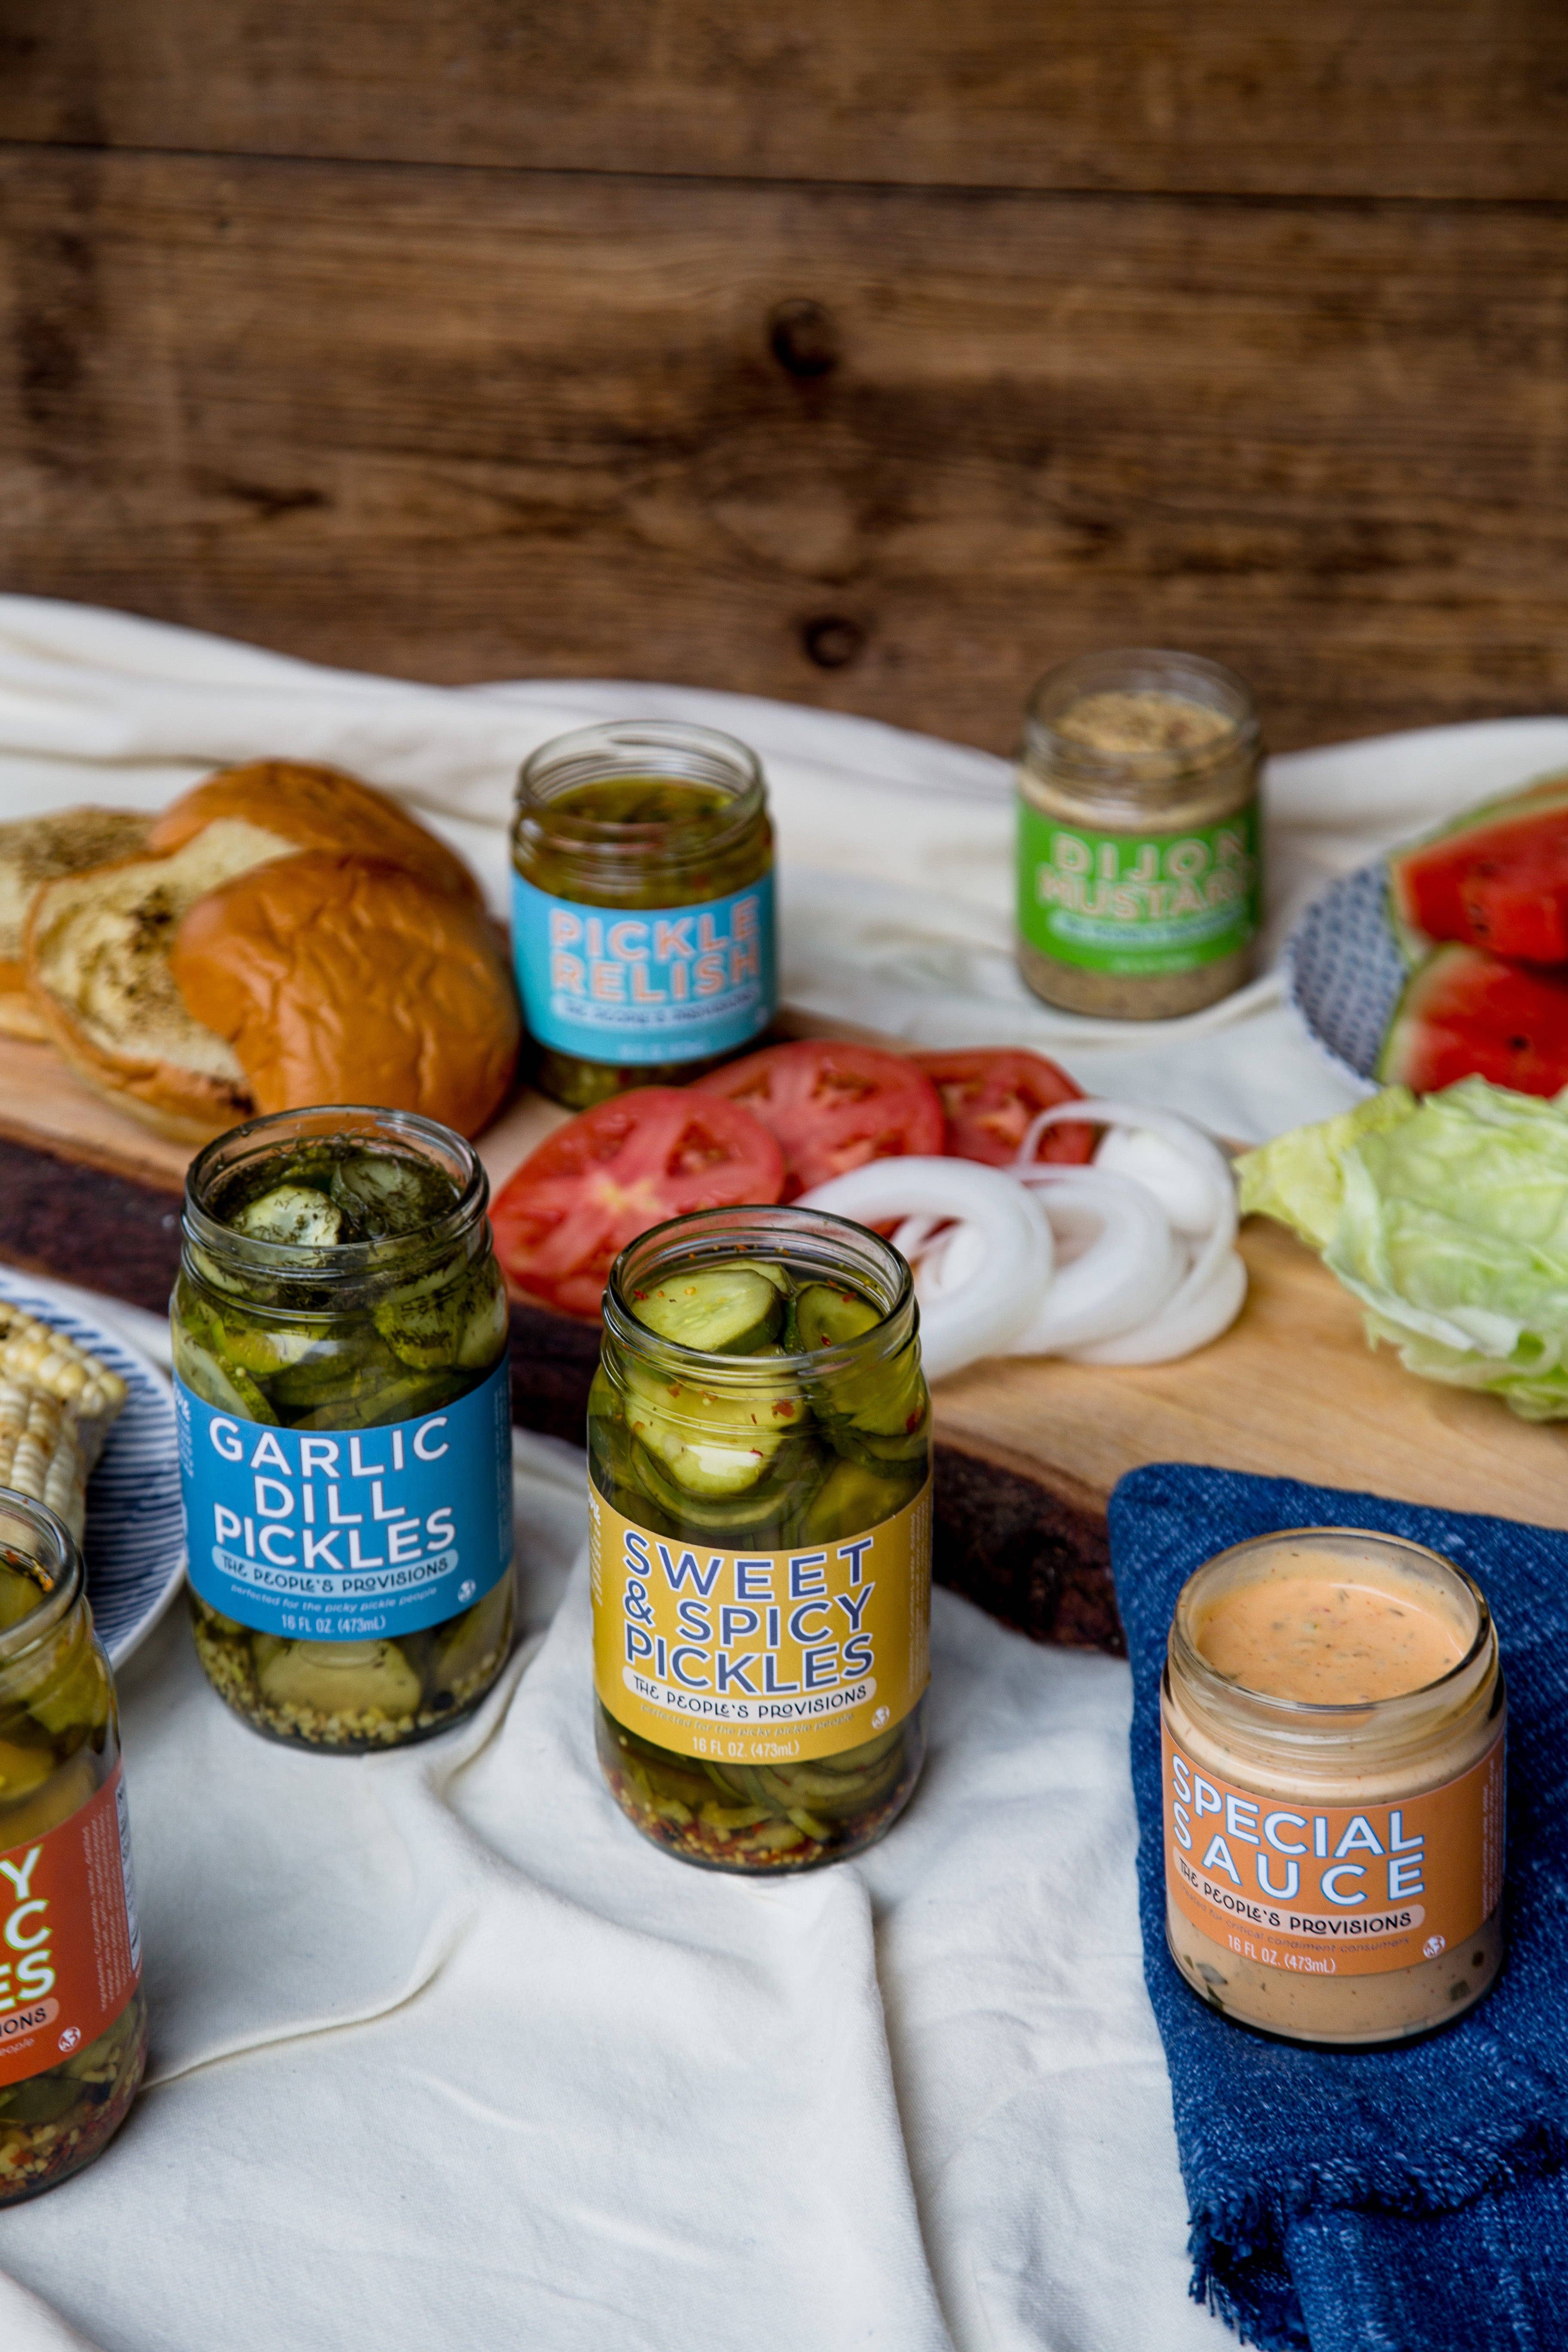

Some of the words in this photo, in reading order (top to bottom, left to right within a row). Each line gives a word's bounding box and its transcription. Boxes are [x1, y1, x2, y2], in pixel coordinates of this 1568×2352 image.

[1036, 862, 1250, 921] MUSTAR
[549, 895, 760, 960] PICKLE
[550, 945, 760, 1001] RELISH
[208, 1415, 450, 1479] GARLIC
[253, 1475, 407, 1525] DILL
[213, 1501, 456, 1571] PICKLES
[222, 1555, 247, 1577] THE
[254, 1568, 333, 1592] PEOPLE'S
[342, 1557, 447, 1592] PROVISIONS
[623, 1529, 873, 1603] SWEET
[282, 1598, 300, 1610] for
[302, 1602, 322, 1612] the
[325, 1602, 357, 1614] picky
[360, 1599, 396, 1612] pickle
[282, 1614, 296, 1630] 16
[299, 1616, 311, 1632] FL
[315, 1617, 334, 1634] OZ.
[337, 1614, 386, 1634] (473mL)
[623, 1576, 655, 1629] &
[676, 1582, 875, 1649] SPICY
[624, 1618, 875, 1696] PICKLES
[633, 1675, 659, 1699] THE
[667, 1691, 749, 1718] PEOPLE'S
[759, 1685, 866, 1718] PROVISIONS
[640, 1704, 692, 1727] perfected
[695, 1719, 712, 1731] for
[715, 1725, 735, 1735] the
[738, 1726, 771, 1737] picky
[775, 1724, 811, 1736] pickle
[692, 1736, 707, 1753] 16
[710, 1740, 724, 1756] FL
[728, 1742, 748, 1758] OZ.
[751, 1740, 799, 1758] (473mL)
[1171, 1754, 1424, 1859] SPECIAL
[1173, 1799, 1424, 1907] SAUCE
[1179, 1857, 1198, 1887] THE
[1204, 1882, 1281, 1926] PEOPLE'S
[1290, 1912, 1412, 1934] PROVISIONS
[1226, 1920, 1264, 1939] critical
[1268, 1936, 1335, 1952] condiment
[1341, 1936, 1409, 1953] consumers
[1228, 1934, 1241, 1952] 16
[1244, 1941, 1257, 1960] FL
[1261, 1948, 1280, 1966] OZ.
[1284, 1954, 1336, 1974] (473mL)
